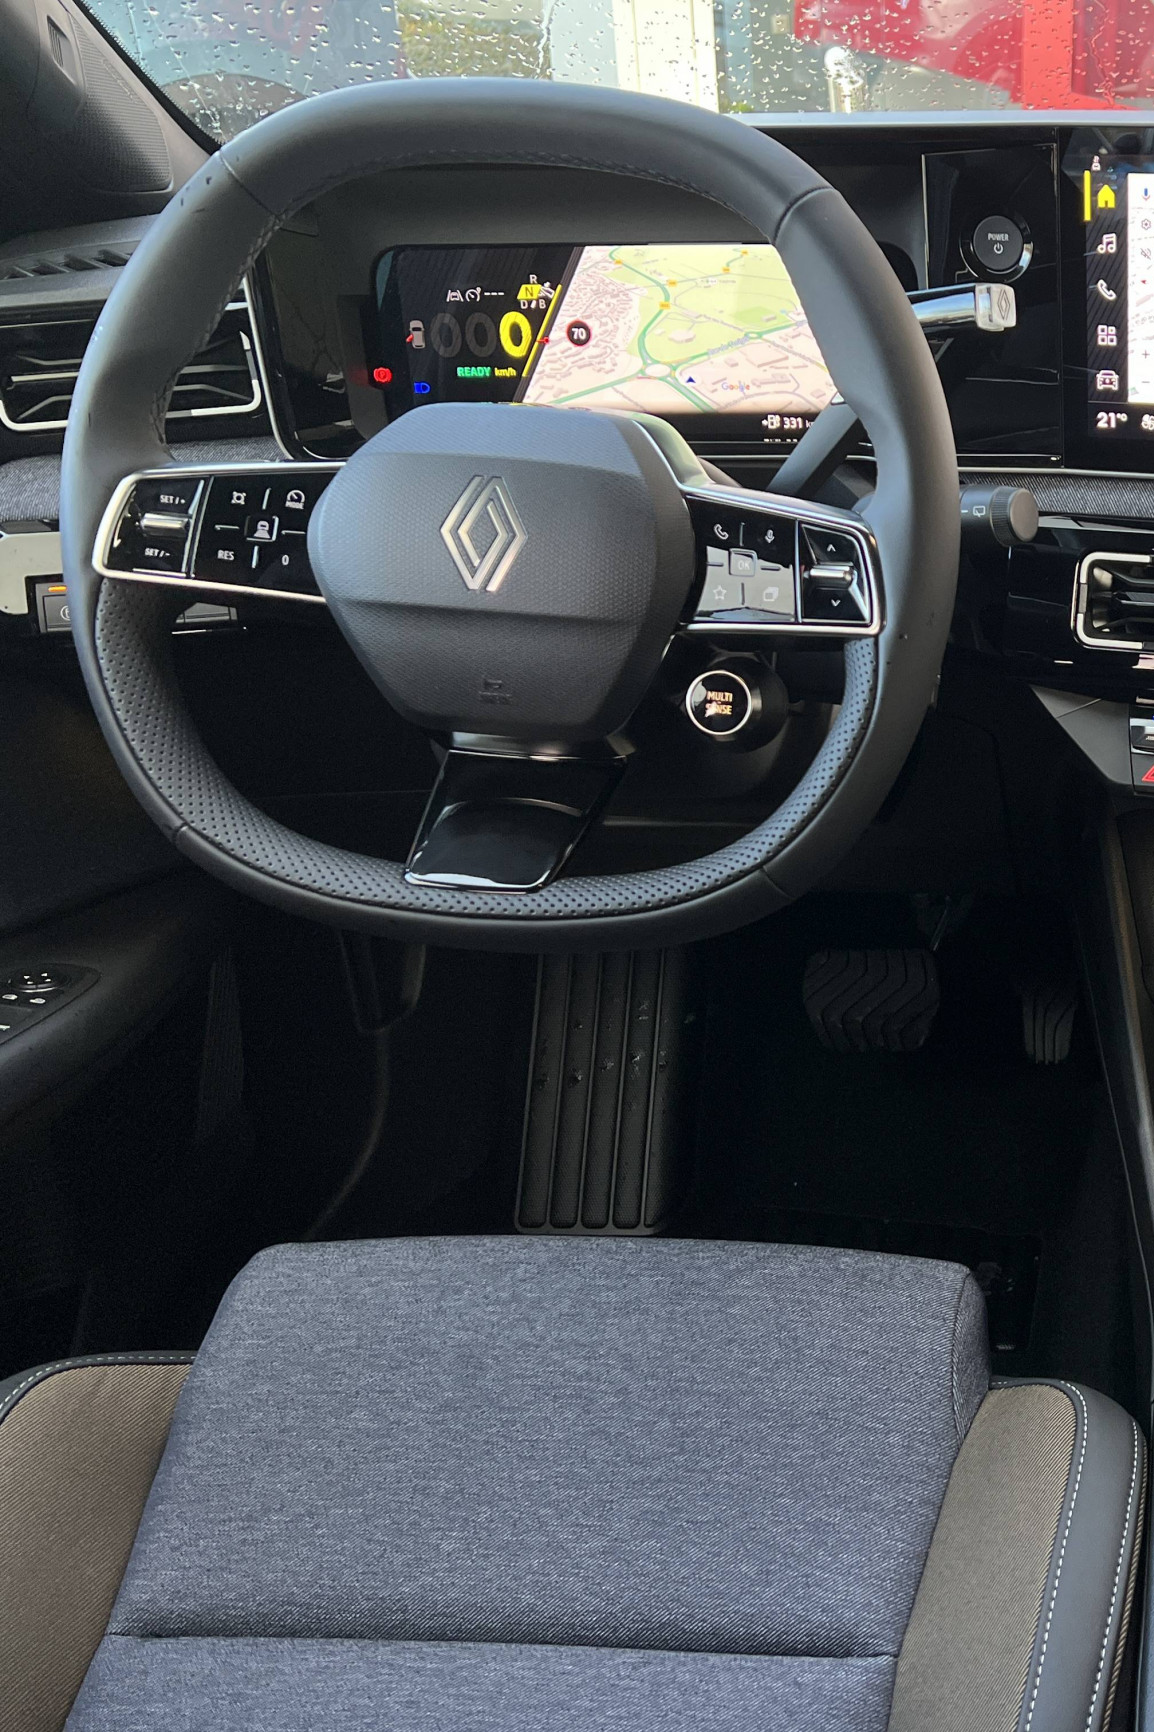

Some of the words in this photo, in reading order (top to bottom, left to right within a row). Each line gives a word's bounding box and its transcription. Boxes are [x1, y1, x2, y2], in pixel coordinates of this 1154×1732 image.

[987, 232, 1009, 241] POWER
[571, 327, 587, 340] 70
[456, 366, 491, 377] READY
[494, 367, 517, 377] km/h
[783, 416, 803, 429] 331
[217, 550, 235, 561] RES
[738, 560, 750, 571] OK
[706, 690, 733, 702] MULTI
